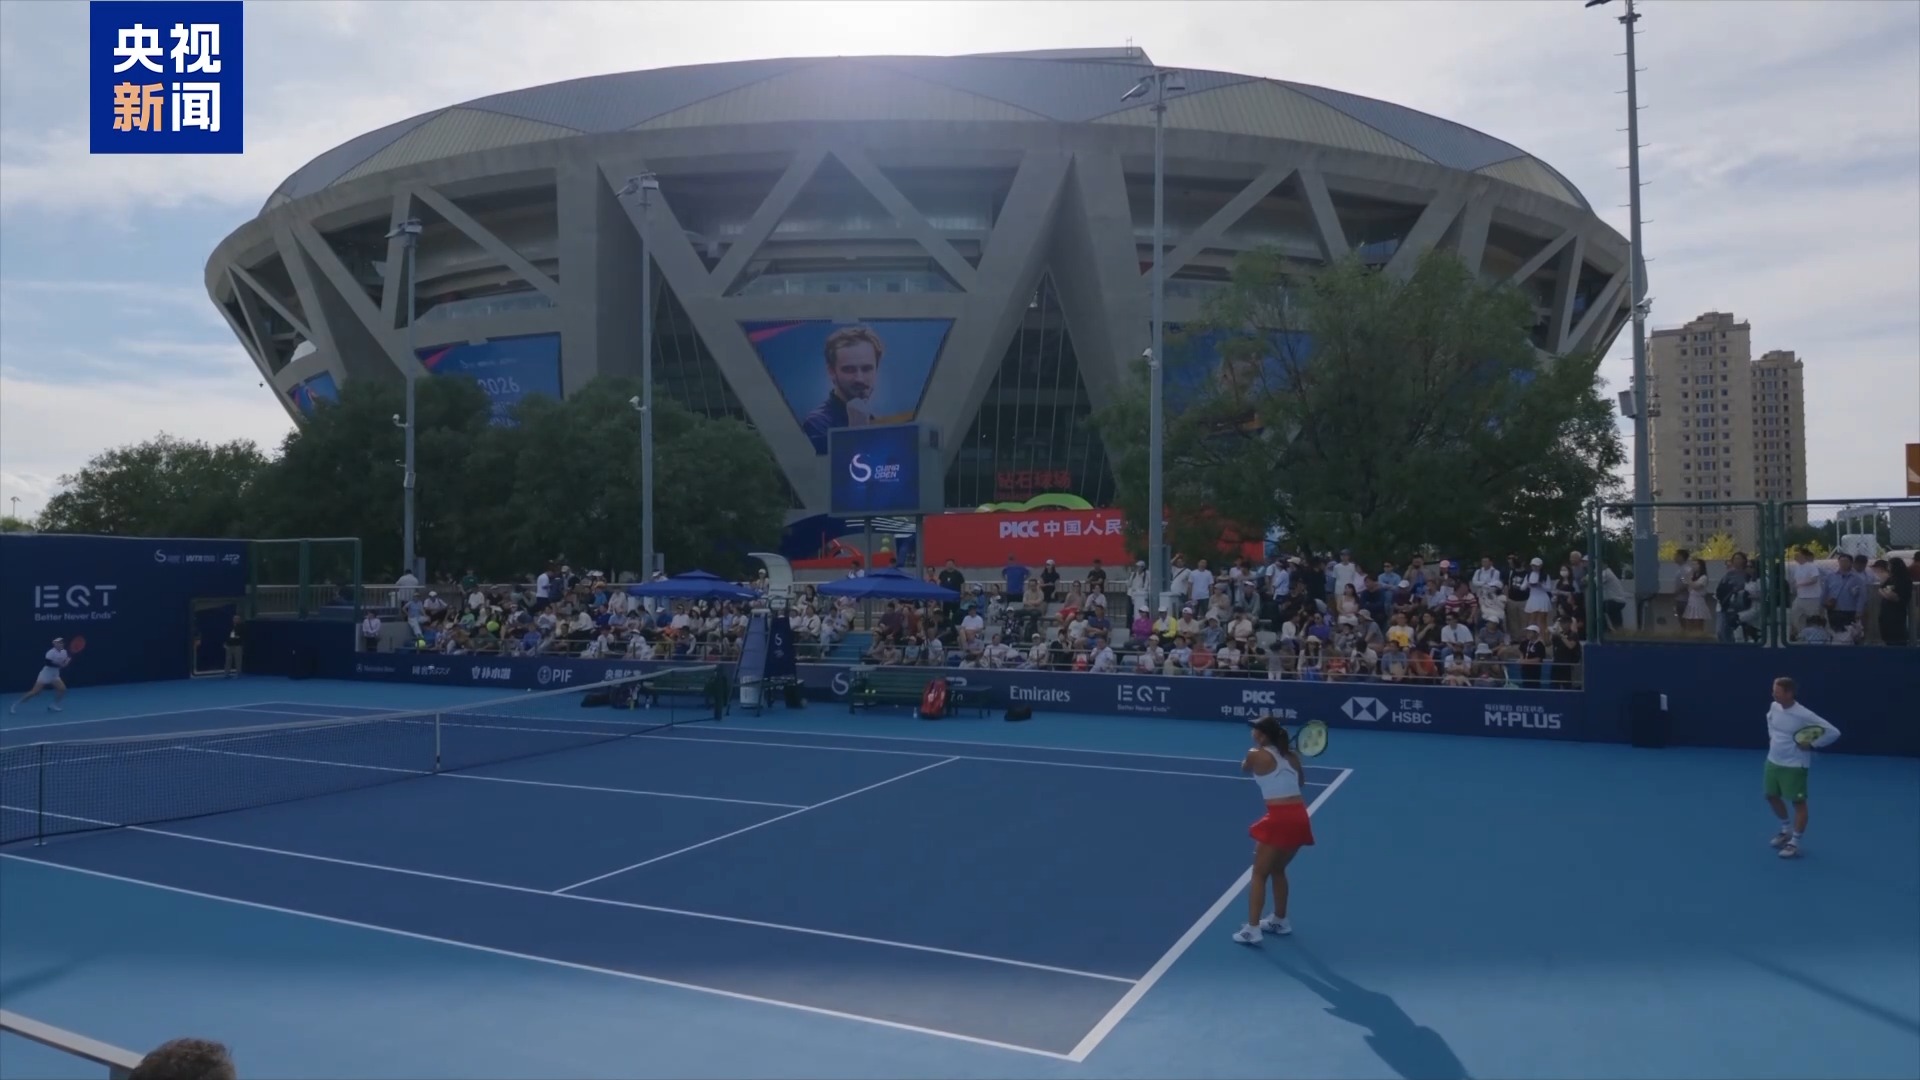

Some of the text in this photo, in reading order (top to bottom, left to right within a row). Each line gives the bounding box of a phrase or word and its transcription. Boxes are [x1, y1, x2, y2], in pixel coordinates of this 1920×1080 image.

[478, 377, 521, 396] 2026
[874, 471, 897, 479] OPEN
[875, 464, 900, 472] CHINA
[1000, 521, 1039, 538] PICC
[35, 585, 117, 608] EQT
[34, 613, 62, 622] Better
[64, 612, 90, 621] Never
[552, 668, 573, 683] PIF
[1010, 685, 1071, 702] Emirates
[1117, 685, 1171, 702] EQT
[1242, 690, 1276, 704] PICC
[1400, 699, 1424, 710] 汇丰
[1221, 705, 1298, 719] 中国人民保险
[1392, 711, 1432, 725] HSBC
[1484, 711, 1561, 729] M-PLUS
